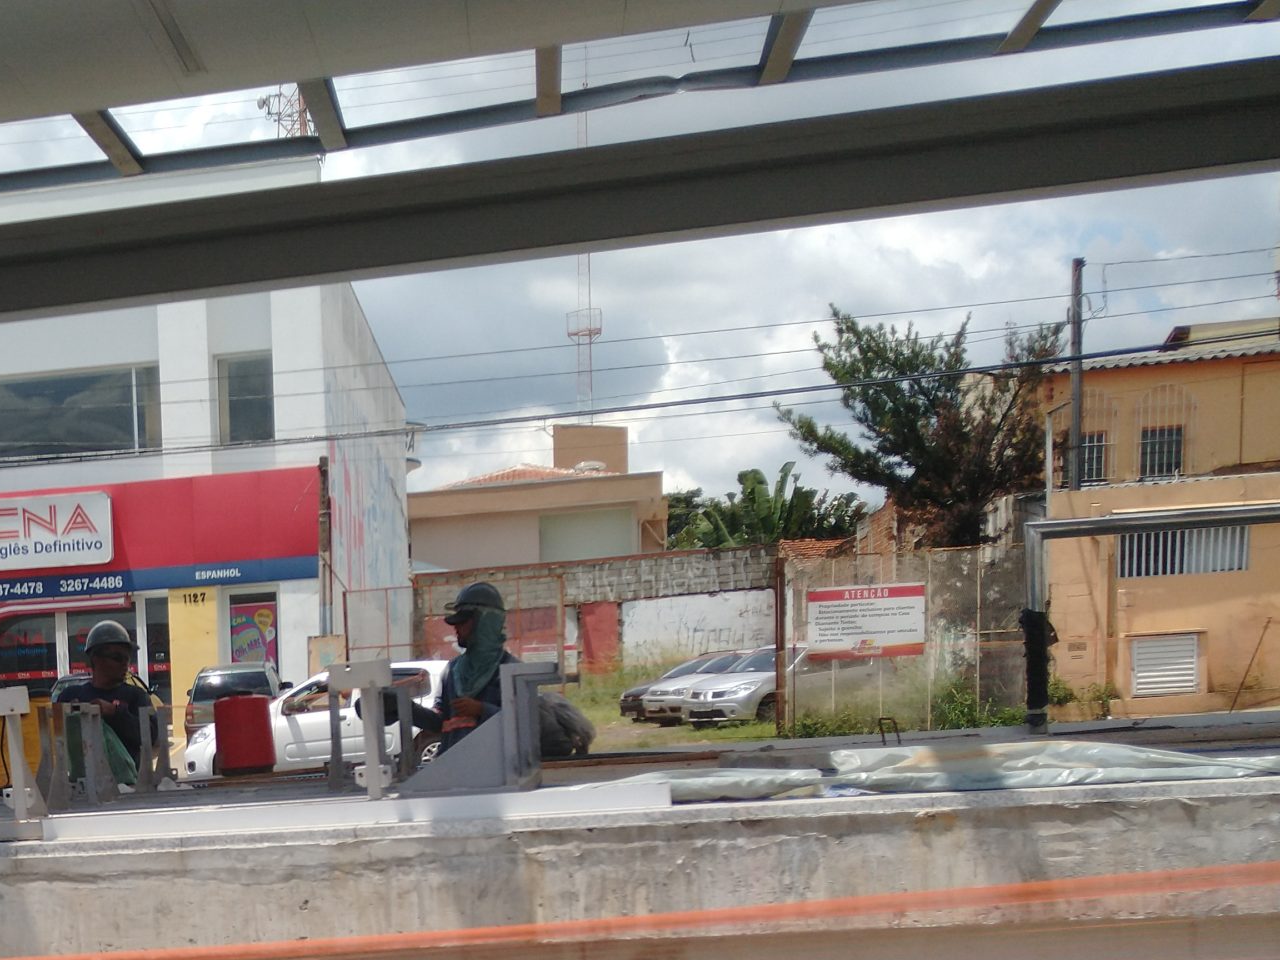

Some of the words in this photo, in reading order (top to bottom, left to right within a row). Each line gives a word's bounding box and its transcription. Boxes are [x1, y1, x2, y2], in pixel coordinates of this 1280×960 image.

[34, 538, 104, 555] Definitivo
[195, 568, 242, 580] ESPANHOL
[60, 576, 123, 592] 3267-4486
[183, 592, 207, 605] 1127
